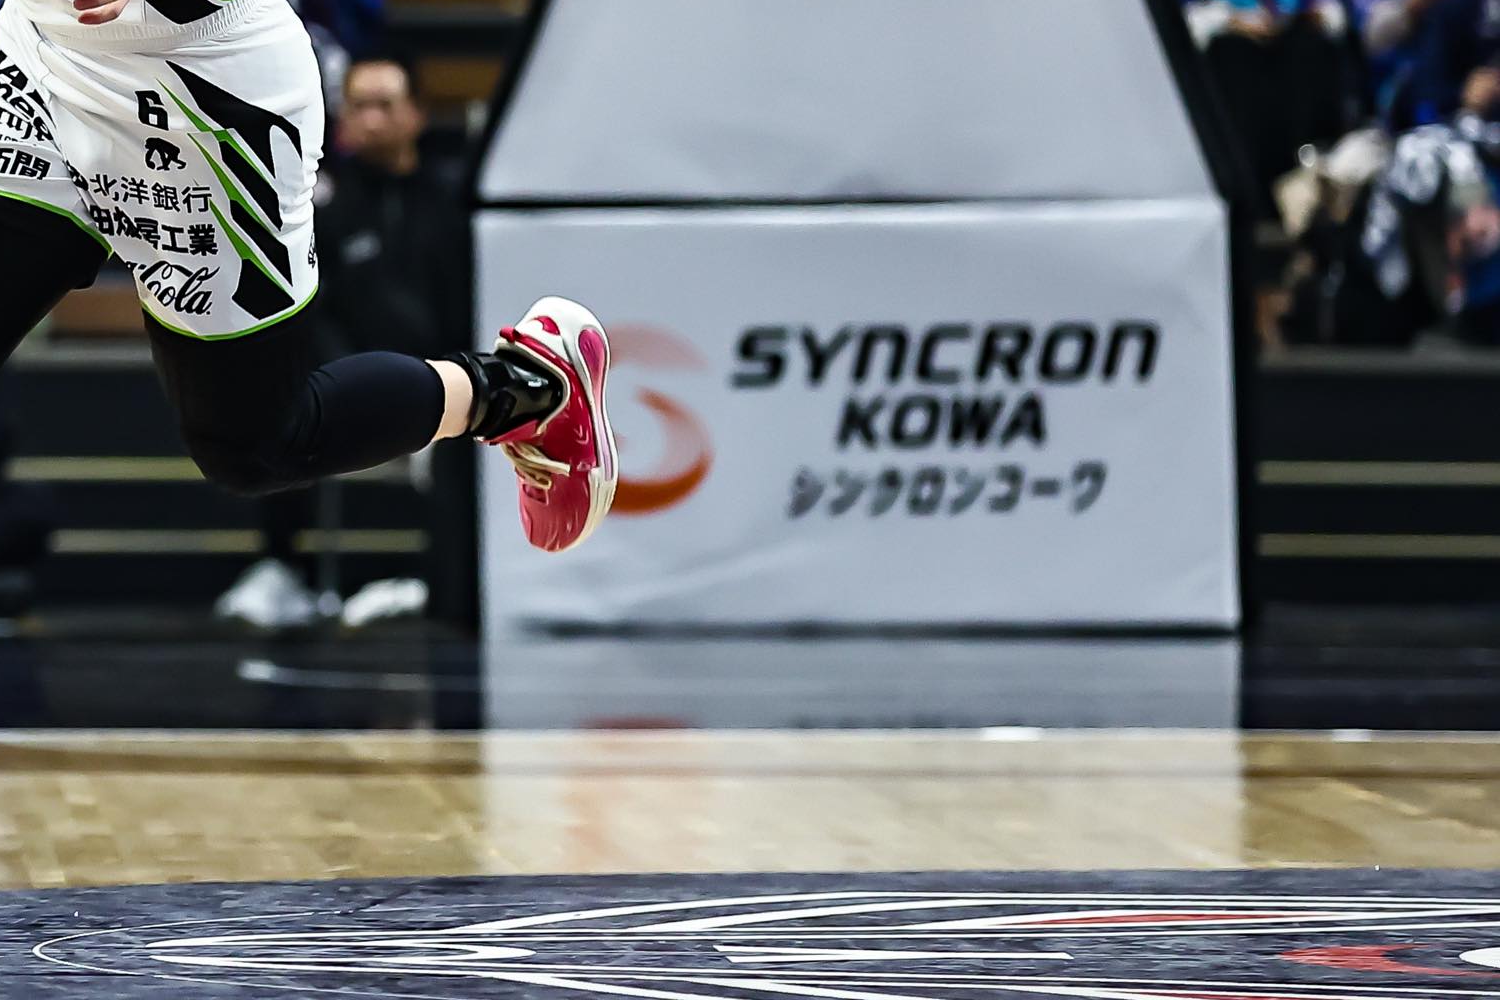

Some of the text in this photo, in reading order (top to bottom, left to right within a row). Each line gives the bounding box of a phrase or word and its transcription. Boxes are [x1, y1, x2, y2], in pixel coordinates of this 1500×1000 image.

[134, 88, 171, 131] 6
[89, 173, 213, 214] 北洋銀行
[835, 391, 1048, 451] KOWA
[787, 460, 1109, 519] シンクロンコーワ
